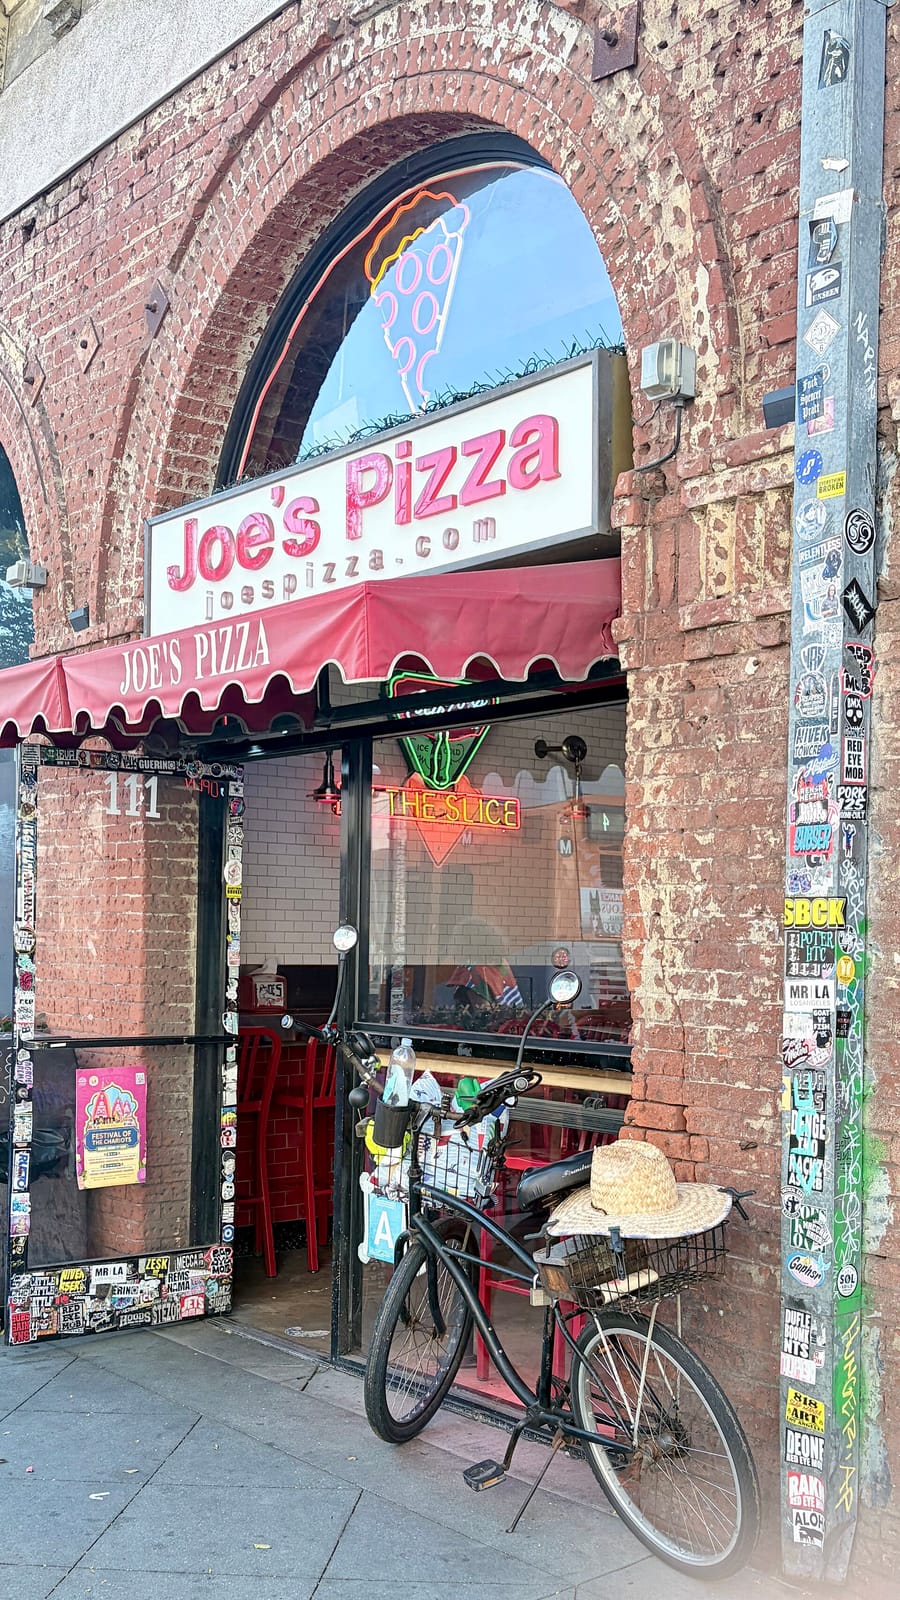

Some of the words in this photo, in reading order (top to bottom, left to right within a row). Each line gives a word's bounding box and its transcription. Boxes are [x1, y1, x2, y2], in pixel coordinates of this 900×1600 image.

[819, 482, 844, 494] BROKEN
[167, 485, 320, 593] Joe's
[345, 414, 562, 540] Pizza
[205, 516, 497, 621] joespizza.com
[120, 638, 182, 695] JOE'S
[194, 617, 270, 680] PIZZA
[847, 740, 863, 753] RED
[847, 755, 862, 766] EYE
[845, 767, 864, 780] MOB
[104, 771, 161, 819] 111
[837, 786, 867, 801] PORK
[386, 789, 437, 819] THE
[445, 794, 517, 827] SLICE
[838, 798, 866, 810] 125
[800, 930, 834, 949] POTER
[806, 946, 826, 962] HTC
[790, 985, 808, 999] MR
[815, 985, 830, 999] LA
[92, 1131, 121, 1140] FESTIVAL
[122, 1129, 132, 1137] OF
[103, 1136, 132, 1145] CHARIOTS
[373, 1211, 394, 1249] A
[146, 1257, 168, 1270] ZESK
[95, 1268, 109, 1277] MR
[113, 1266, 123, 1275] LA
[168, 1270, 190, 1283] REMS
[62, 1304, 80, 1314] RED
[182, 1295, 205, 1311] JETS
[62, 1312, 81, 1321] EYE
[61, 1320, 81, 1331] MOB
[793, 1391, 818, 1409] 818
[791, 1407, 818, 1424] ART
[787, 1429, 825, 1461] DEONE
[800, 1456, 811, 1467] EYE
